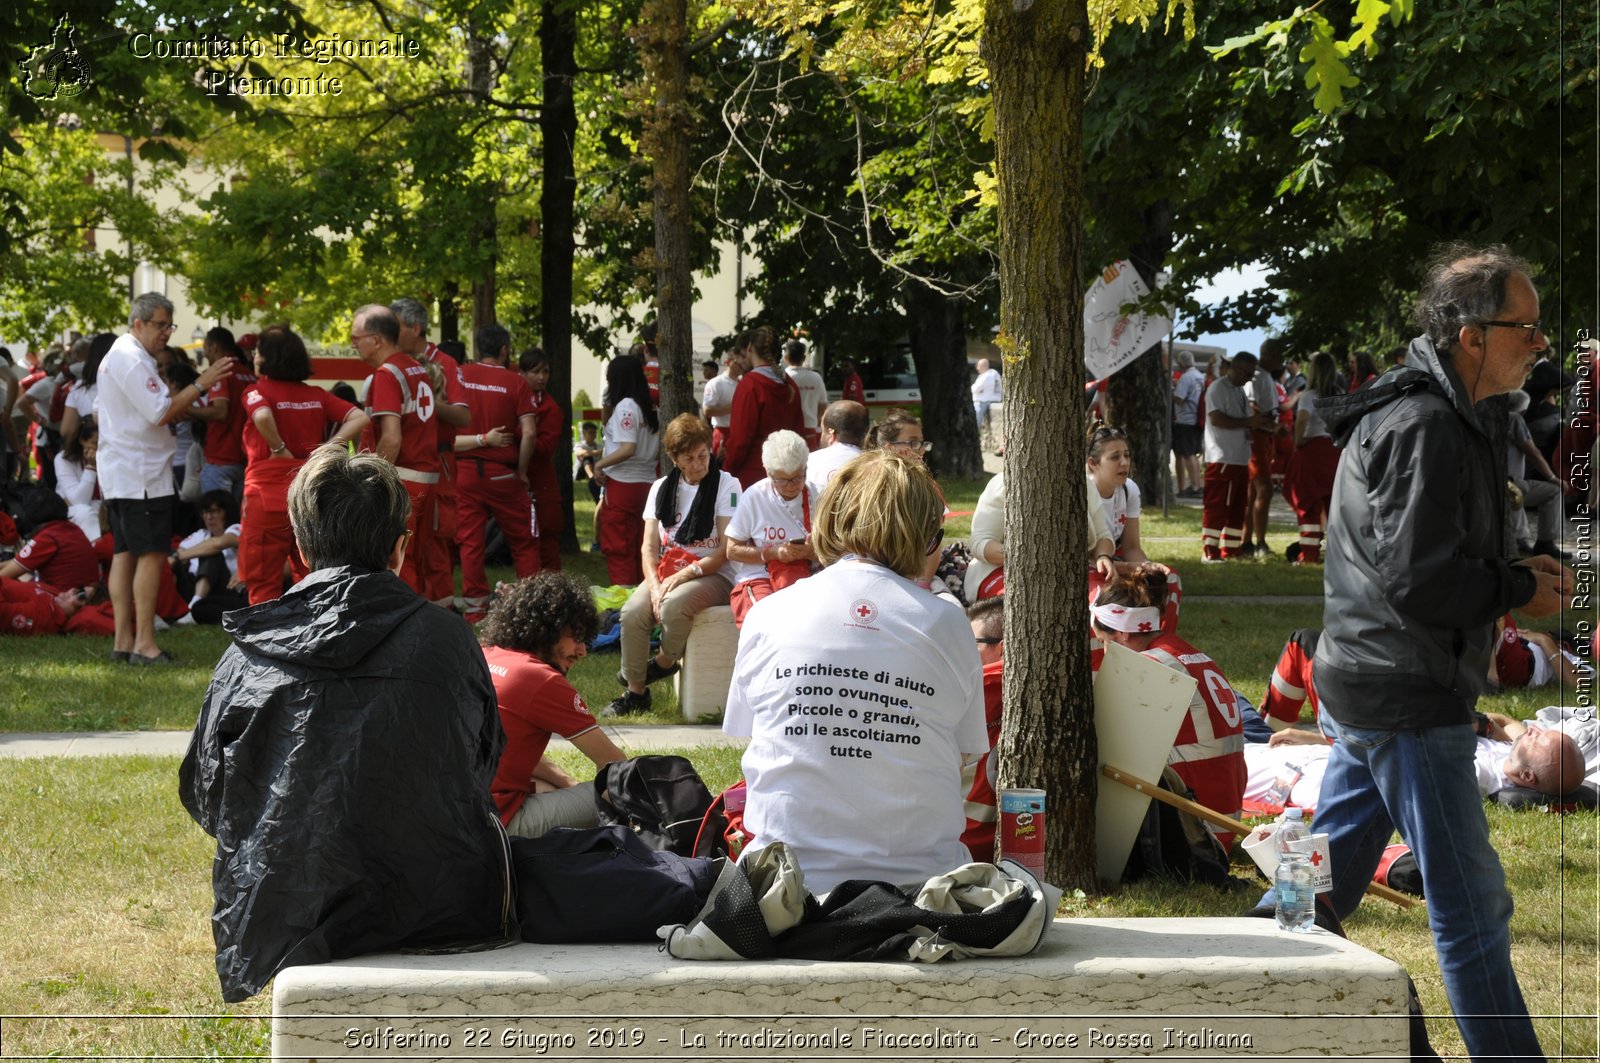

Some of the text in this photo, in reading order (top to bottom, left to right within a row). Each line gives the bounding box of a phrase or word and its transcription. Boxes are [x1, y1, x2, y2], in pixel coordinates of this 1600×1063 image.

[763, 527, 786, 540] 100
[775, 663, 935, 697] Le richieste di aiuto
[795, 685, 913, 710] sono ovunque.
[788, 703, 920, 729] Piccole o grandi,
[785, 723, 921, 746] noi le ascoltiamo
[830, 743, 873, 760] tutte
